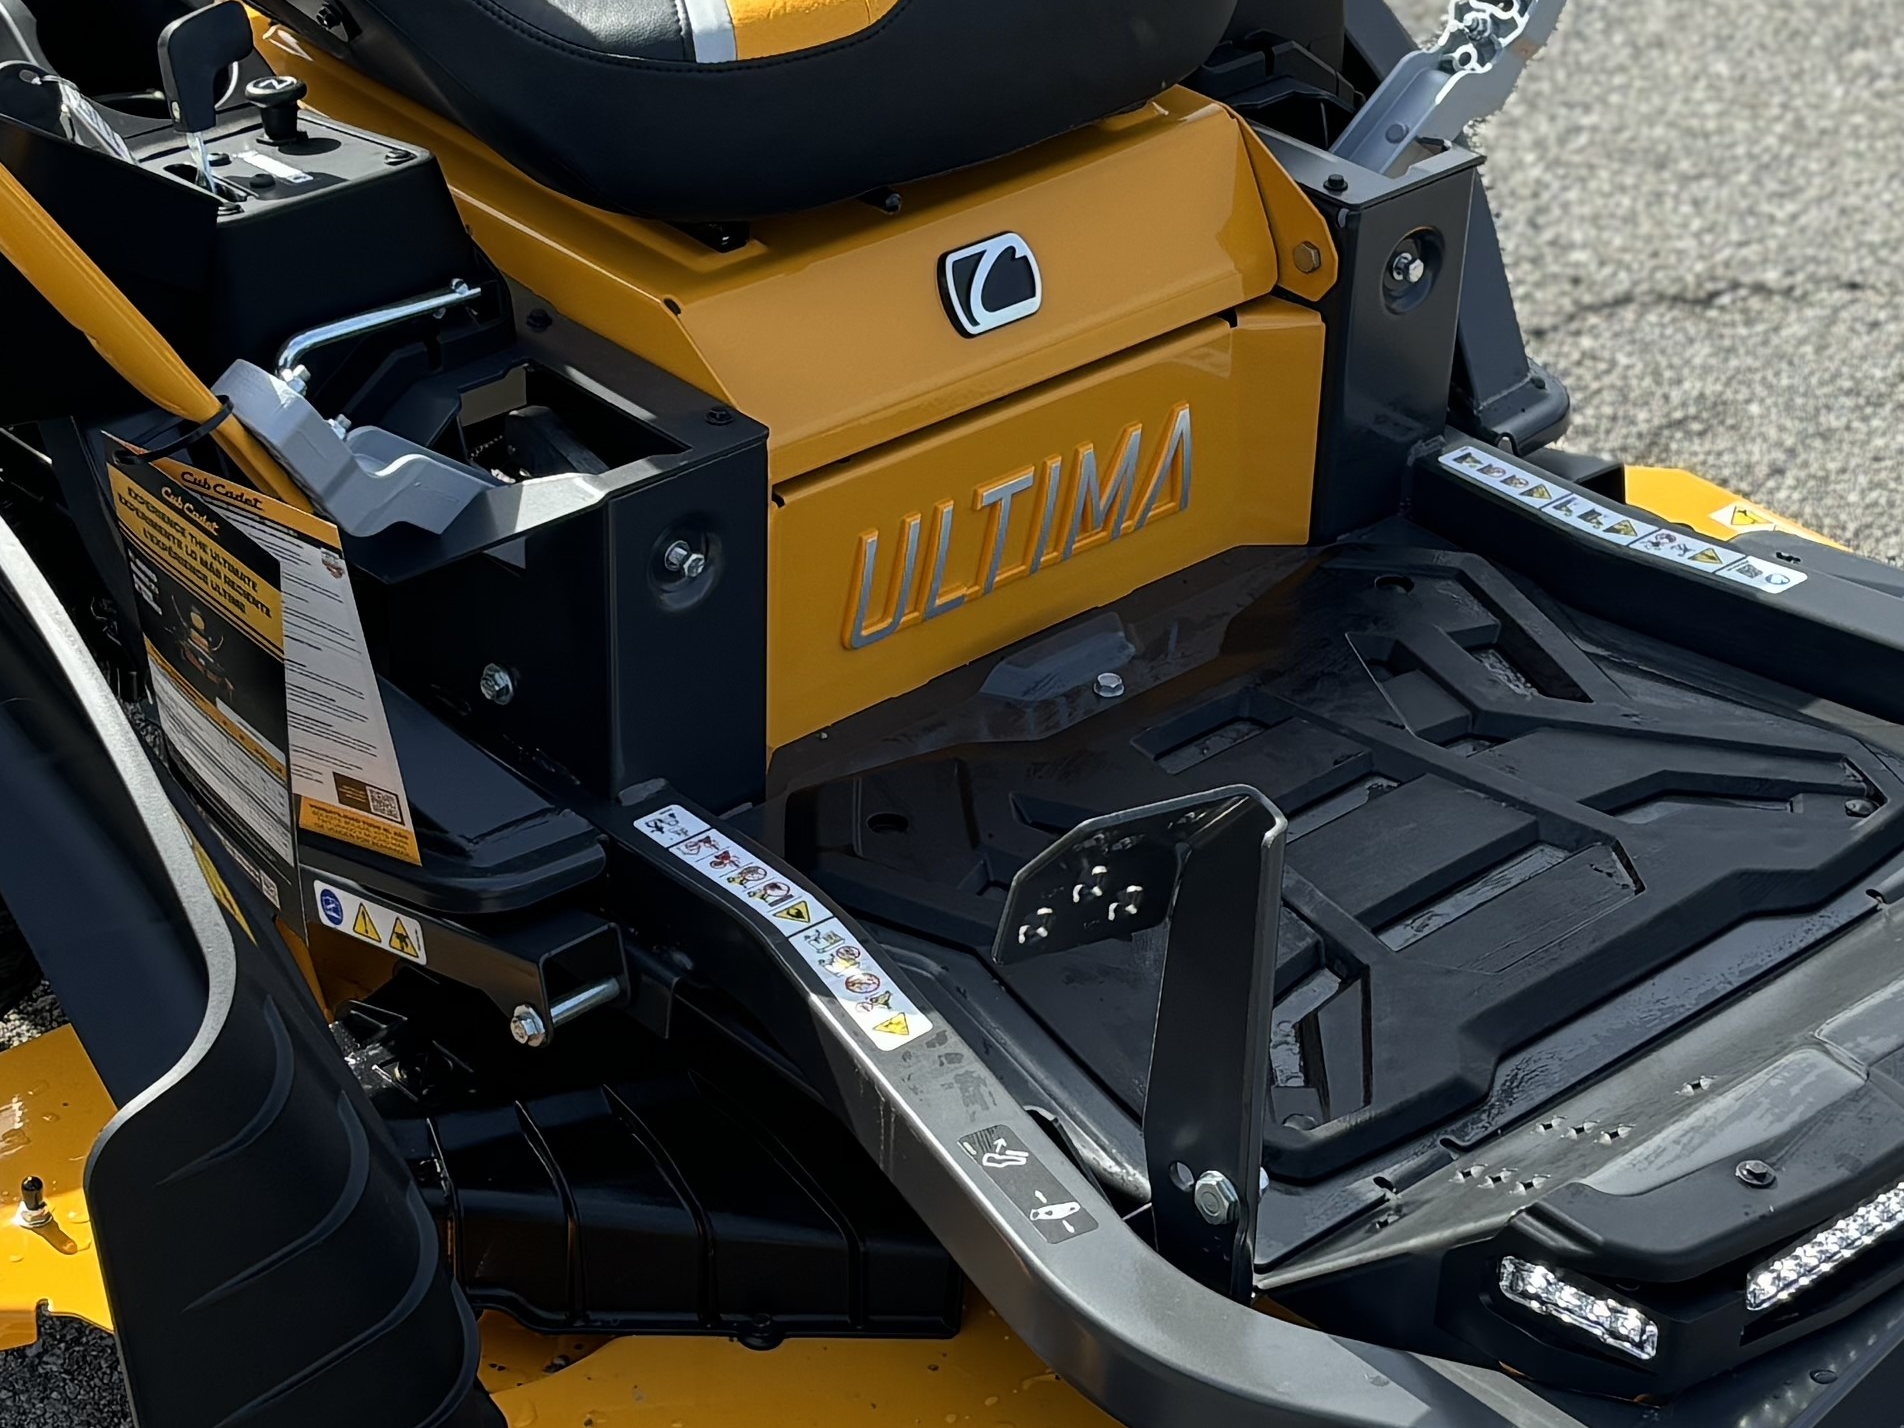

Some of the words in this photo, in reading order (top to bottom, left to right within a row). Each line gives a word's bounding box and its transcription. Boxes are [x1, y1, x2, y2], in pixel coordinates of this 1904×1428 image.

[161, 486, 184, 510] Cub
[183, 502, 219, 536] Cadet
[181, 471, 212, 491] Cub
[212, 483, 265, 512] Cadet
[843, 403, 1193, 653] ULTIMA
[188, 532, 208, 556] THE
[209, 547, 257, 593] ULTIMATE
